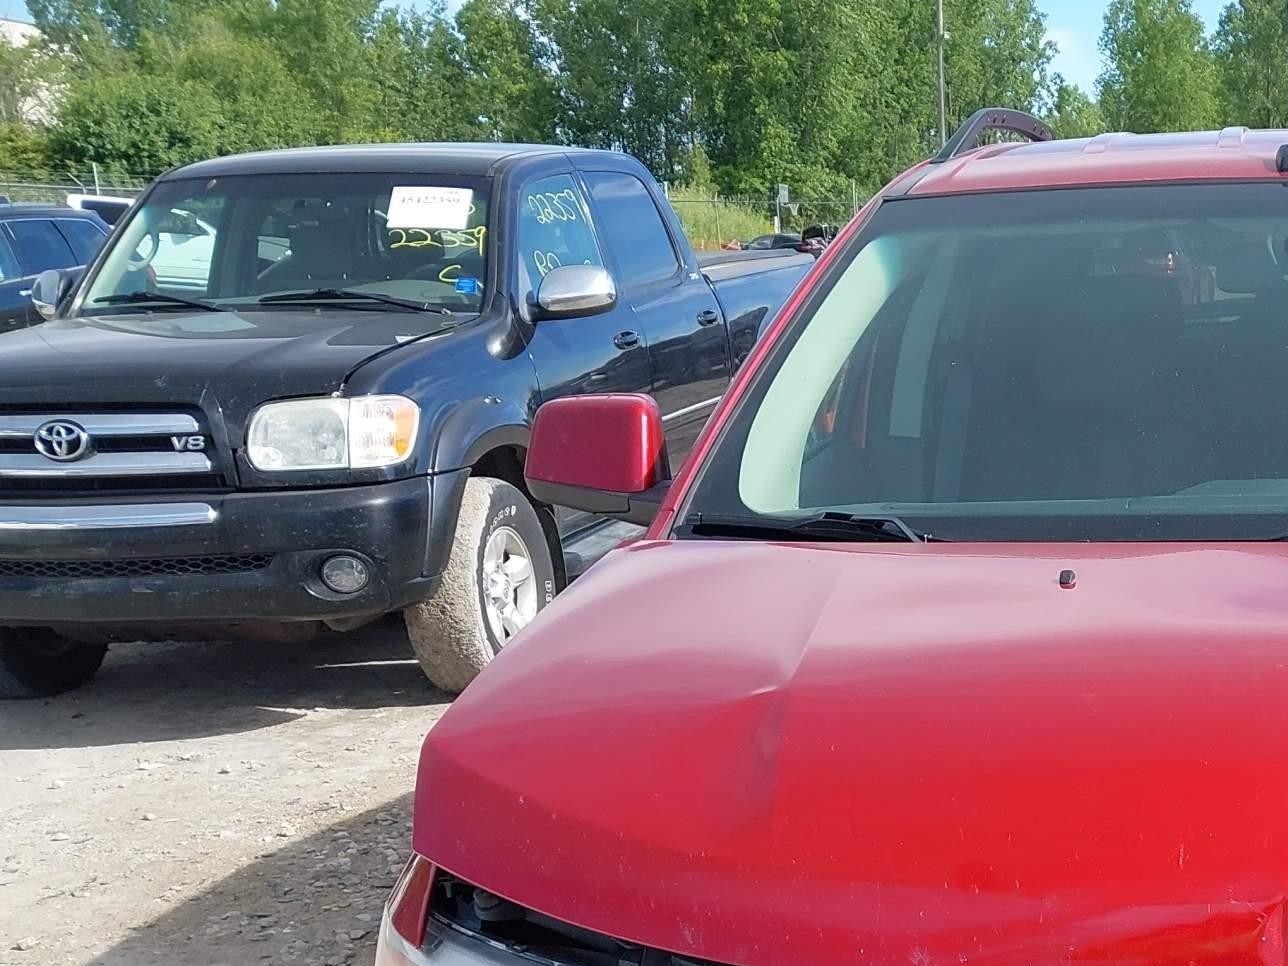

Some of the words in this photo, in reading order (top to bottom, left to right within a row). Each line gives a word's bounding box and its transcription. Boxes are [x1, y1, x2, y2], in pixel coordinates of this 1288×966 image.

[527, 189, 587, 224] 22359
[388, 226, 486, 256] 22359
[170, 435, 205, 451] V8
